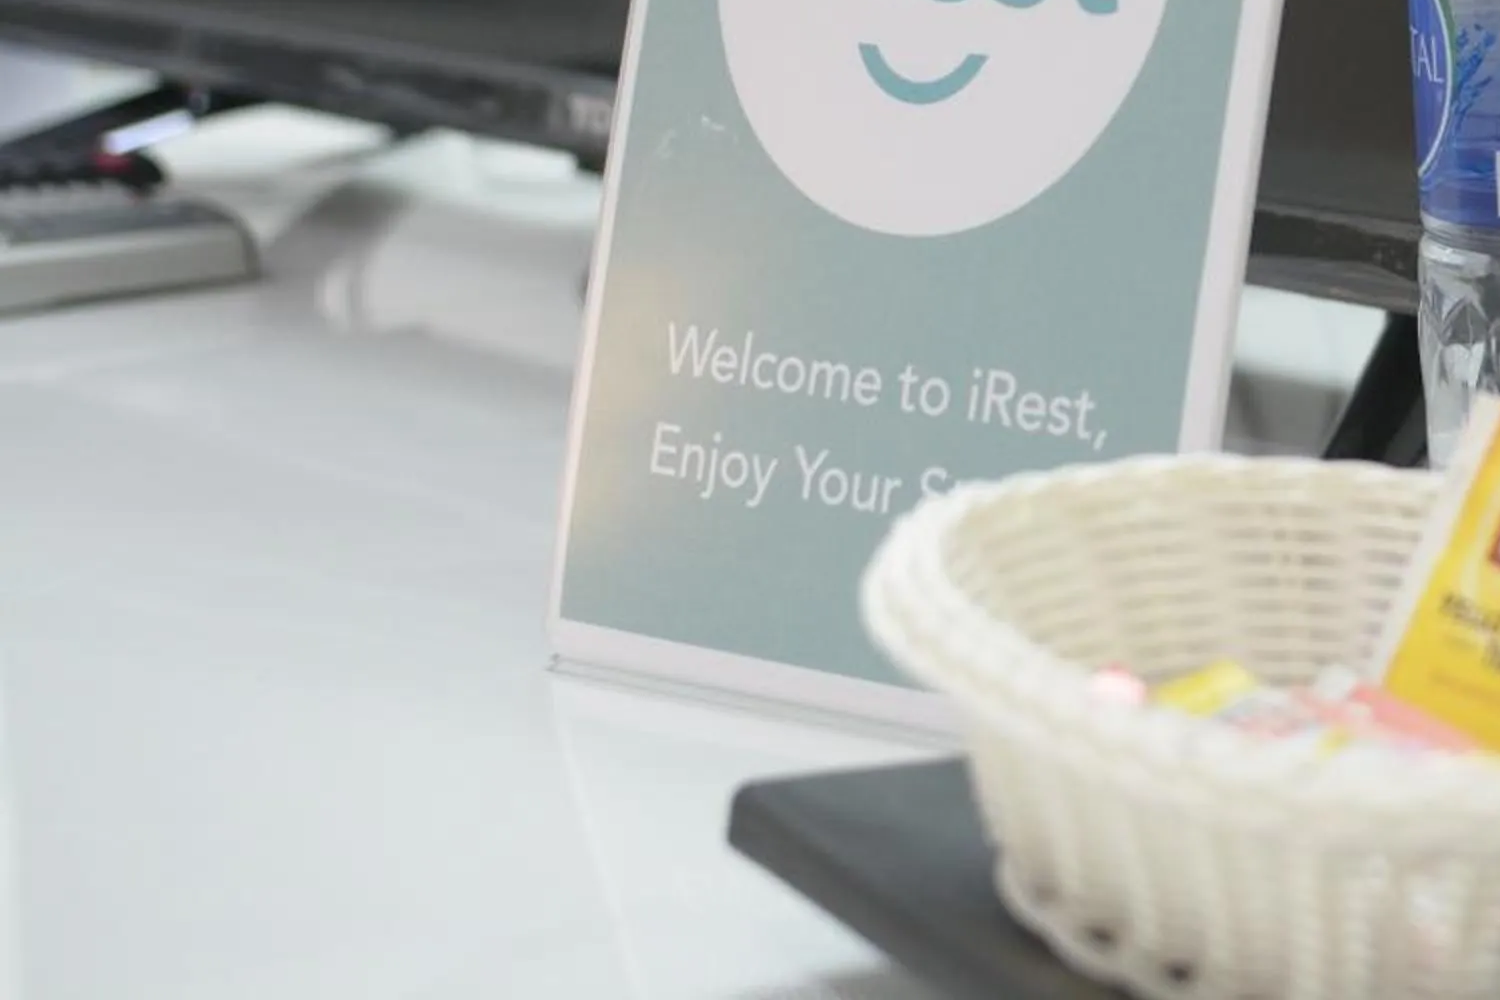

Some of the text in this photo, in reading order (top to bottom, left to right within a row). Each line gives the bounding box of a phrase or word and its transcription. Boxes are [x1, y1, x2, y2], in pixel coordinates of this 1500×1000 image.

[669, 321, 1107, 450] Welcome to iRest,
[649, 421, 778, 507] Enjoy
[796, 445, 901, 513] Your
